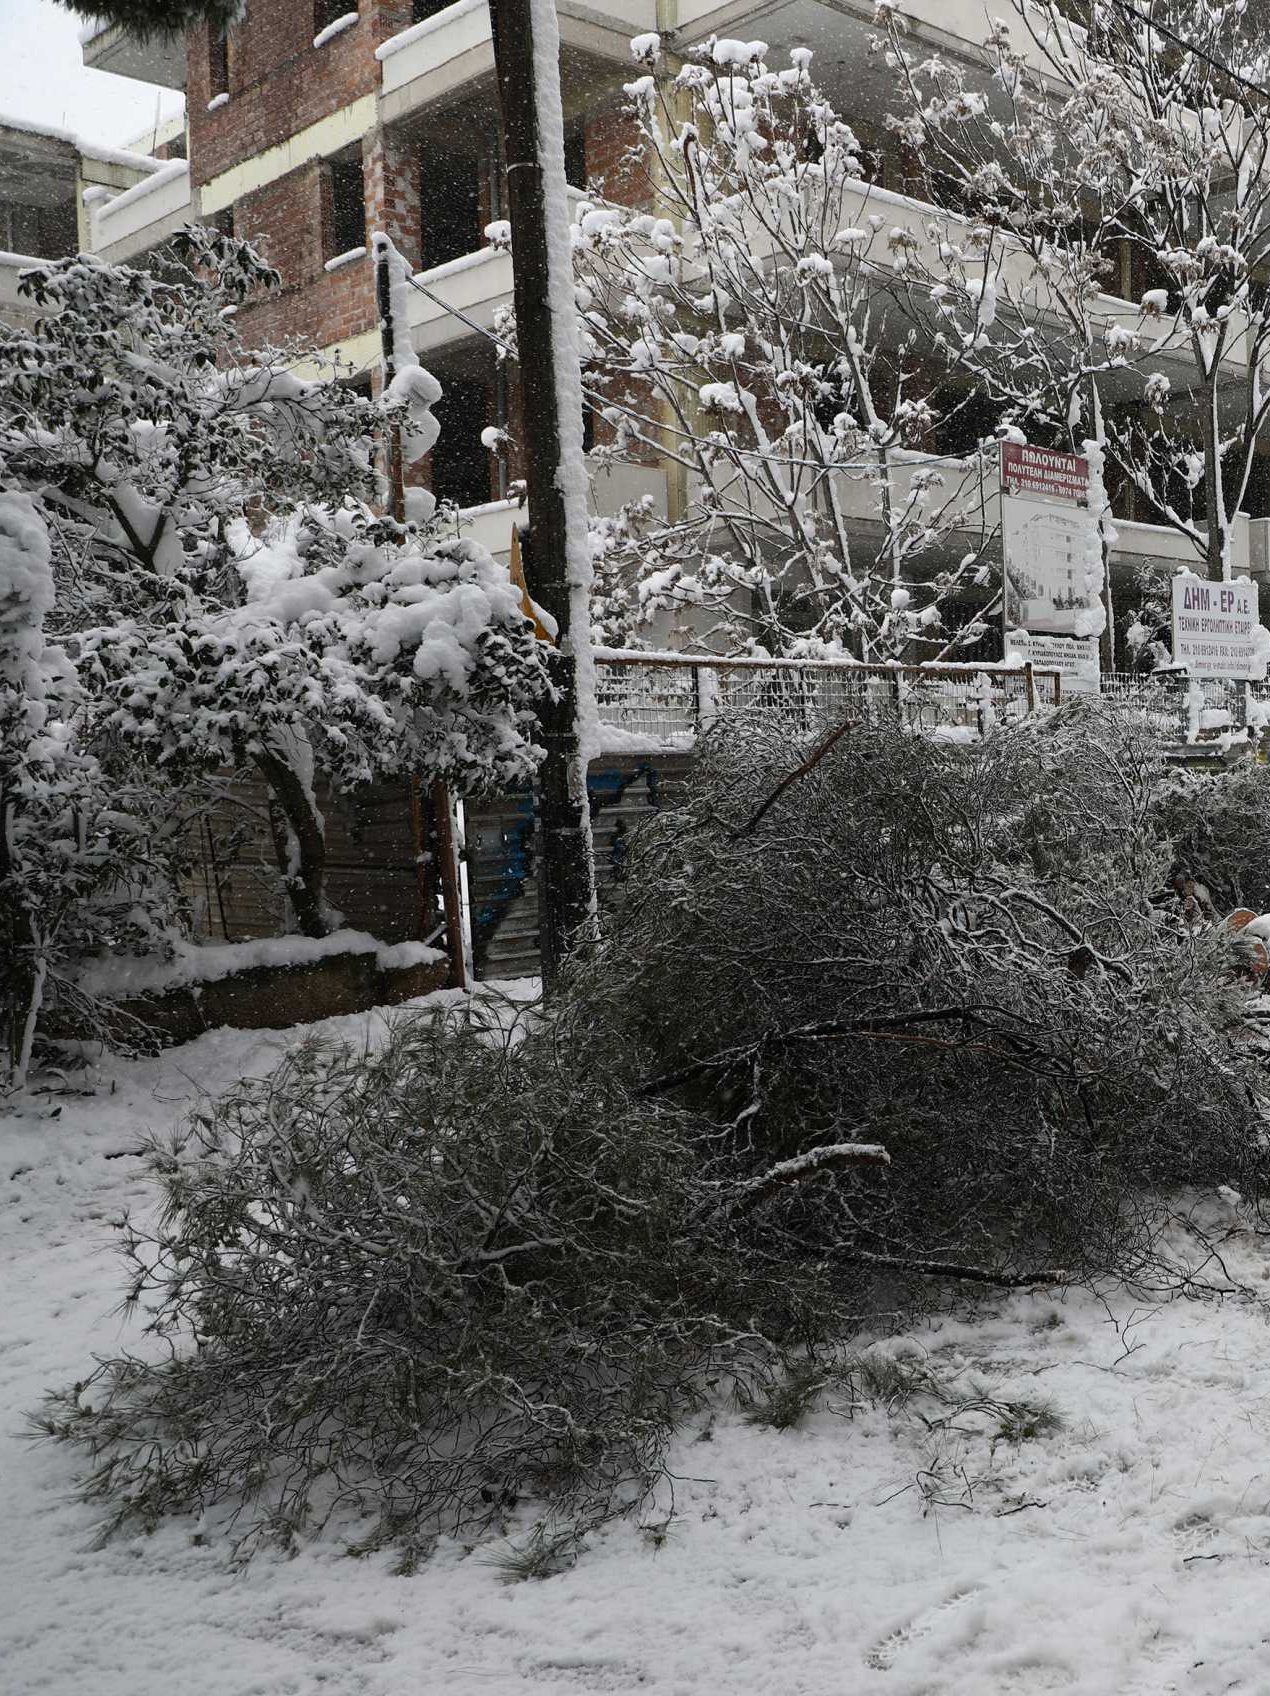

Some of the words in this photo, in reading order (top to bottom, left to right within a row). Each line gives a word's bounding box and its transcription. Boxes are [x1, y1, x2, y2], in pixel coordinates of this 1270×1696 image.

[1022, 449, 1076, 472] ΠΩΛΟΥΝΤΑΙ
[1008, 462, 1041, 478] ΠΟΛΥΤΕΛΗ
[1043, 468, 1089, 486] ΔΙΑΜΕΡΙΣΜΑΤΑ
[1184, 587, 1210, 611] ΔΗΜ
[1221, 591, 1235, 613] ΕΡ
[1178, 616, 1200, 632] ΤΕΧΝΙΚΗ
[1201, 618, 1233, 633] ΕΡΓΟΛΗΠΤΙΚΗ
